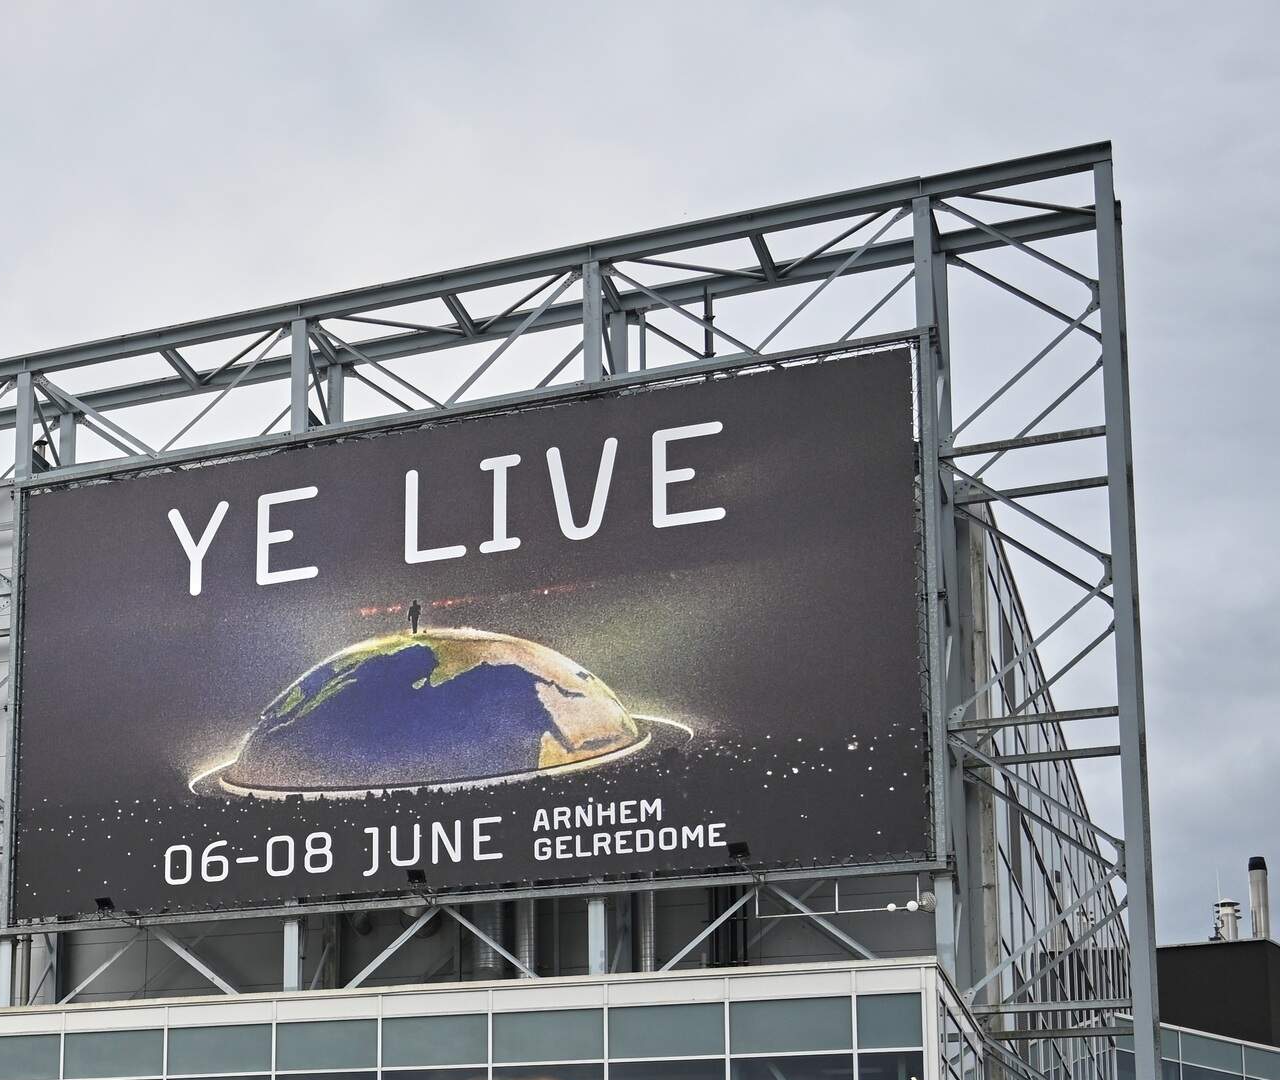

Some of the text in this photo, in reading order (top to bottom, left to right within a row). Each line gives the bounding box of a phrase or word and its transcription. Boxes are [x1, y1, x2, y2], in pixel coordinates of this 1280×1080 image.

[167, 420, 727, 597] YE LIVE
[532, 798, 662, 832] ARNHEM
[533, 822, 727, 861] GELREDOME
[163, 816, 504, 886] 06-08 JUNE
